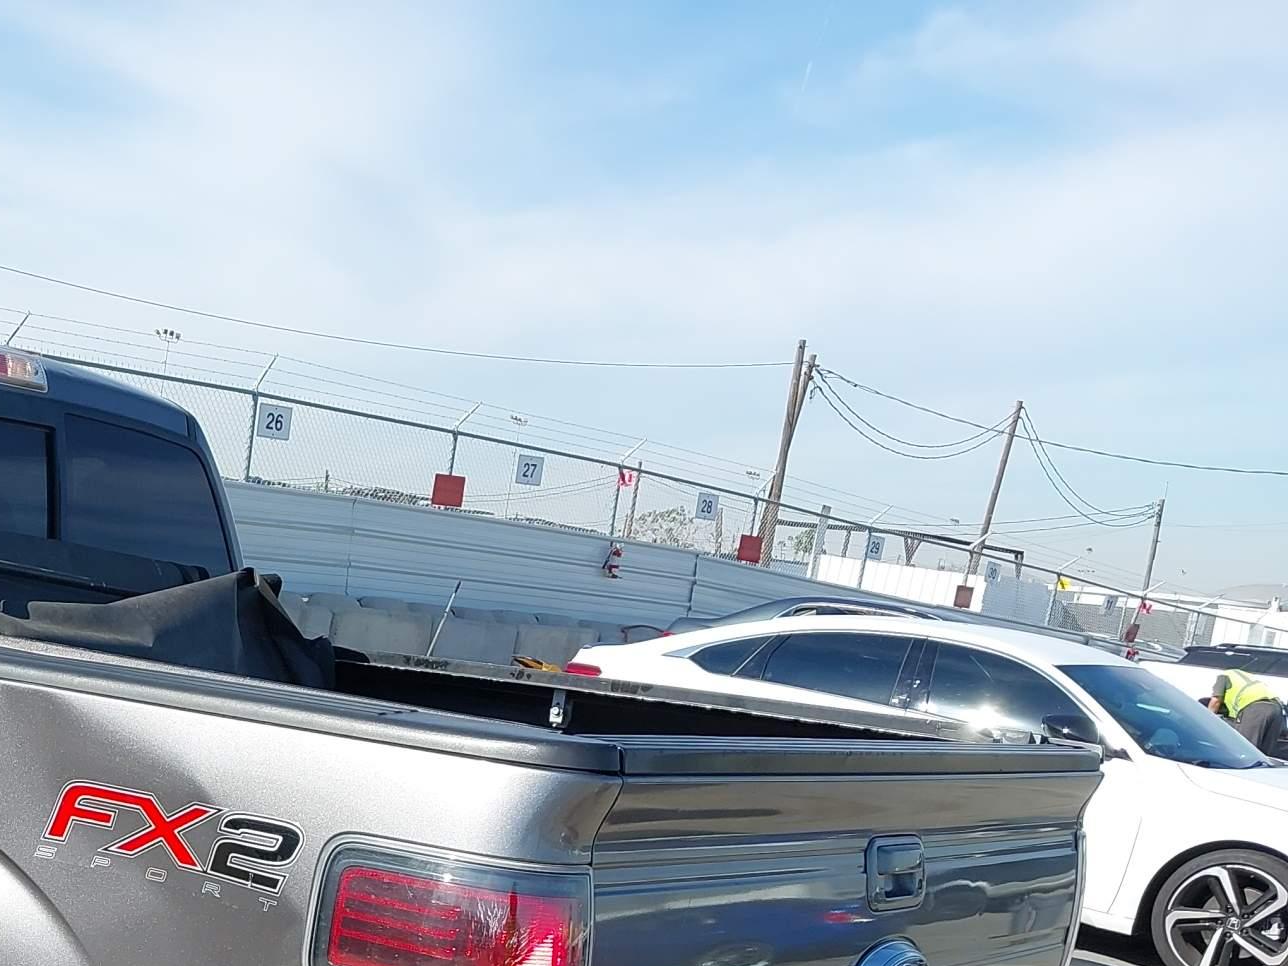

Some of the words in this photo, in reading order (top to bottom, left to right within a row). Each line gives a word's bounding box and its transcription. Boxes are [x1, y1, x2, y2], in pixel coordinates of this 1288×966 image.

[265, 412, 284, 432] 26
[522, 462, 537, 478] 27
[701, 499, 713, 514] 28
[870, 540, 881, 554] 29
[40, 779, 306, 897] FX2
[34, 844, 278, 911] SPORT
